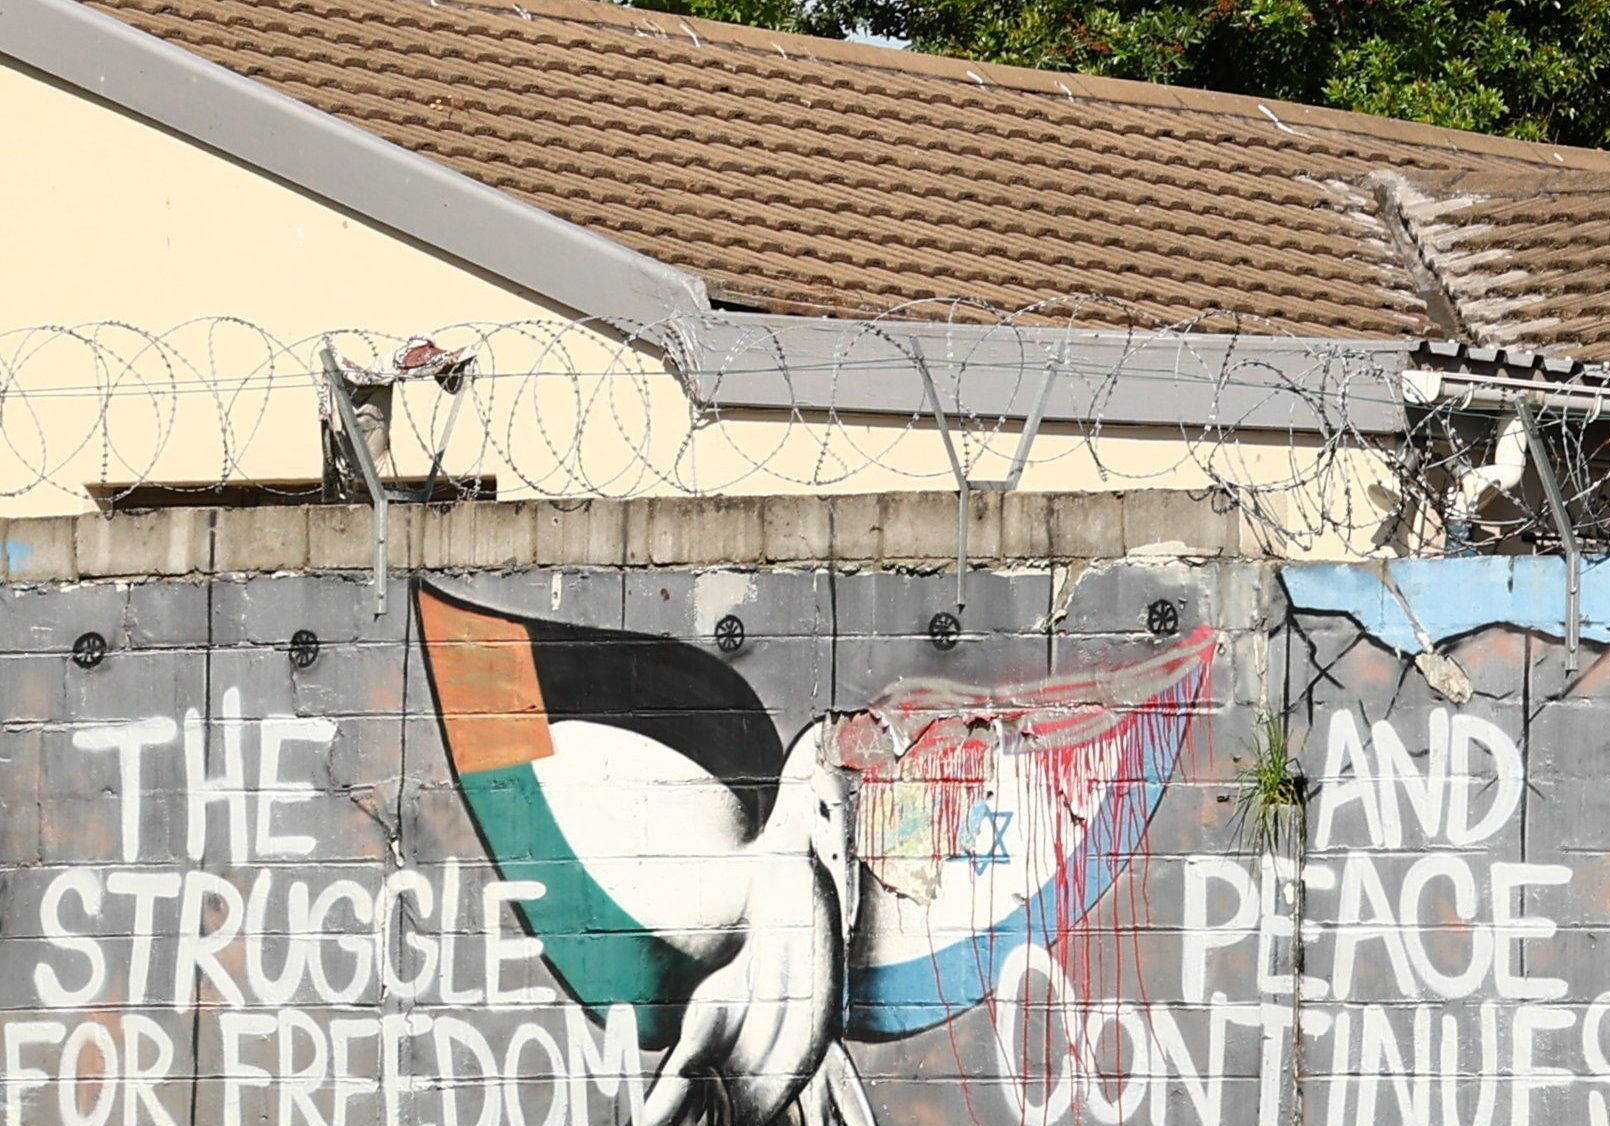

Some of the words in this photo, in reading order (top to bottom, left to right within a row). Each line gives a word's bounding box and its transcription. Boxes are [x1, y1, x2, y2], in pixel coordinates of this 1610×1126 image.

[73, 688, 338, 862] THE
[1315, 708, 1524, 848] AND
[33, 858, 556, 1012] STRUGGLE
[1180, 853, 1574, 1000] PEACE
